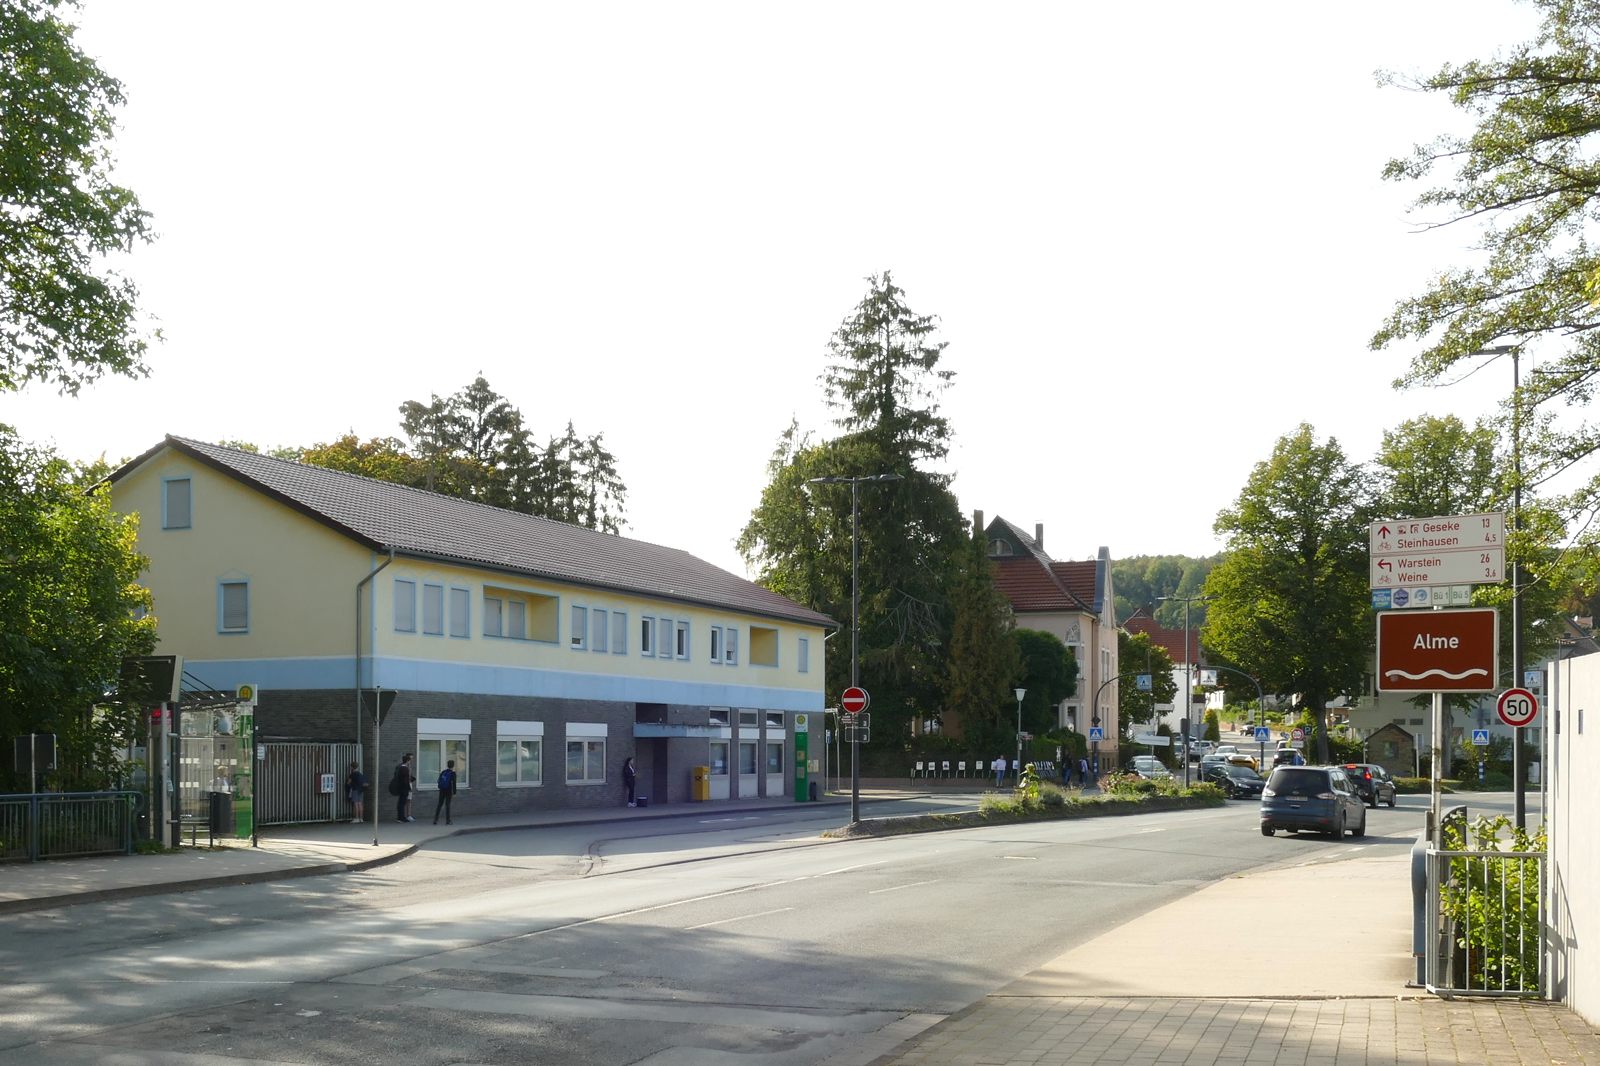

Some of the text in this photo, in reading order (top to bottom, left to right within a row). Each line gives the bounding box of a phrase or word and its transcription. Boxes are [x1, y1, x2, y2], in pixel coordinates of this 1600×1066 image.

[1423, 521, 1460, 532] Geseke
[1482, 518, 1490, 528] 13
[1398, 537, 1458, 548] Steinhausen
[1398, 554, 1490, 568] Warstein 26
[1398, 572, 1428, 582] Weine
[1413, 634, 1460, 650] Alme
[1507, 700, 1529, 716] 50
